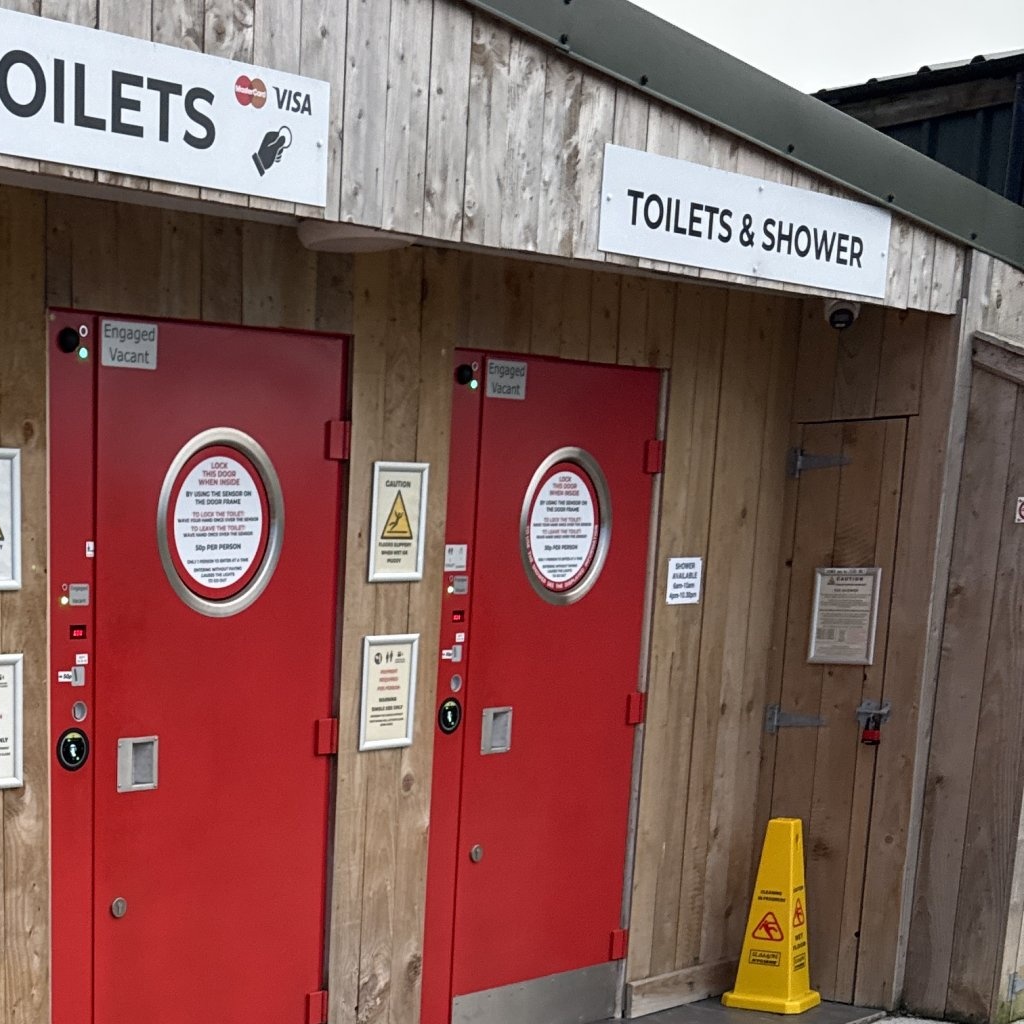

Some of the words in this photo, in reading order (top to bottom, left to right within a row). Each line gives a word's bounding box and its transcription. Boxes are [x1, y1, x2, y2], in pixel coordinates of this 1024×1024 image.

[273, 86, 312, 116] VISA
[627, 189, 732, 243] TOILETS
[739, 213, 754, 248] &
[761, 217, 864, 268] SHOWER
[104, 324, 155, 344] Engaged
[109, 347, 149, 364] Vacant
[489, 362, 525, 379] Engaged
[491, 382, 520, 395] Vacant
[385, 480, 411, 488] CAUTION
